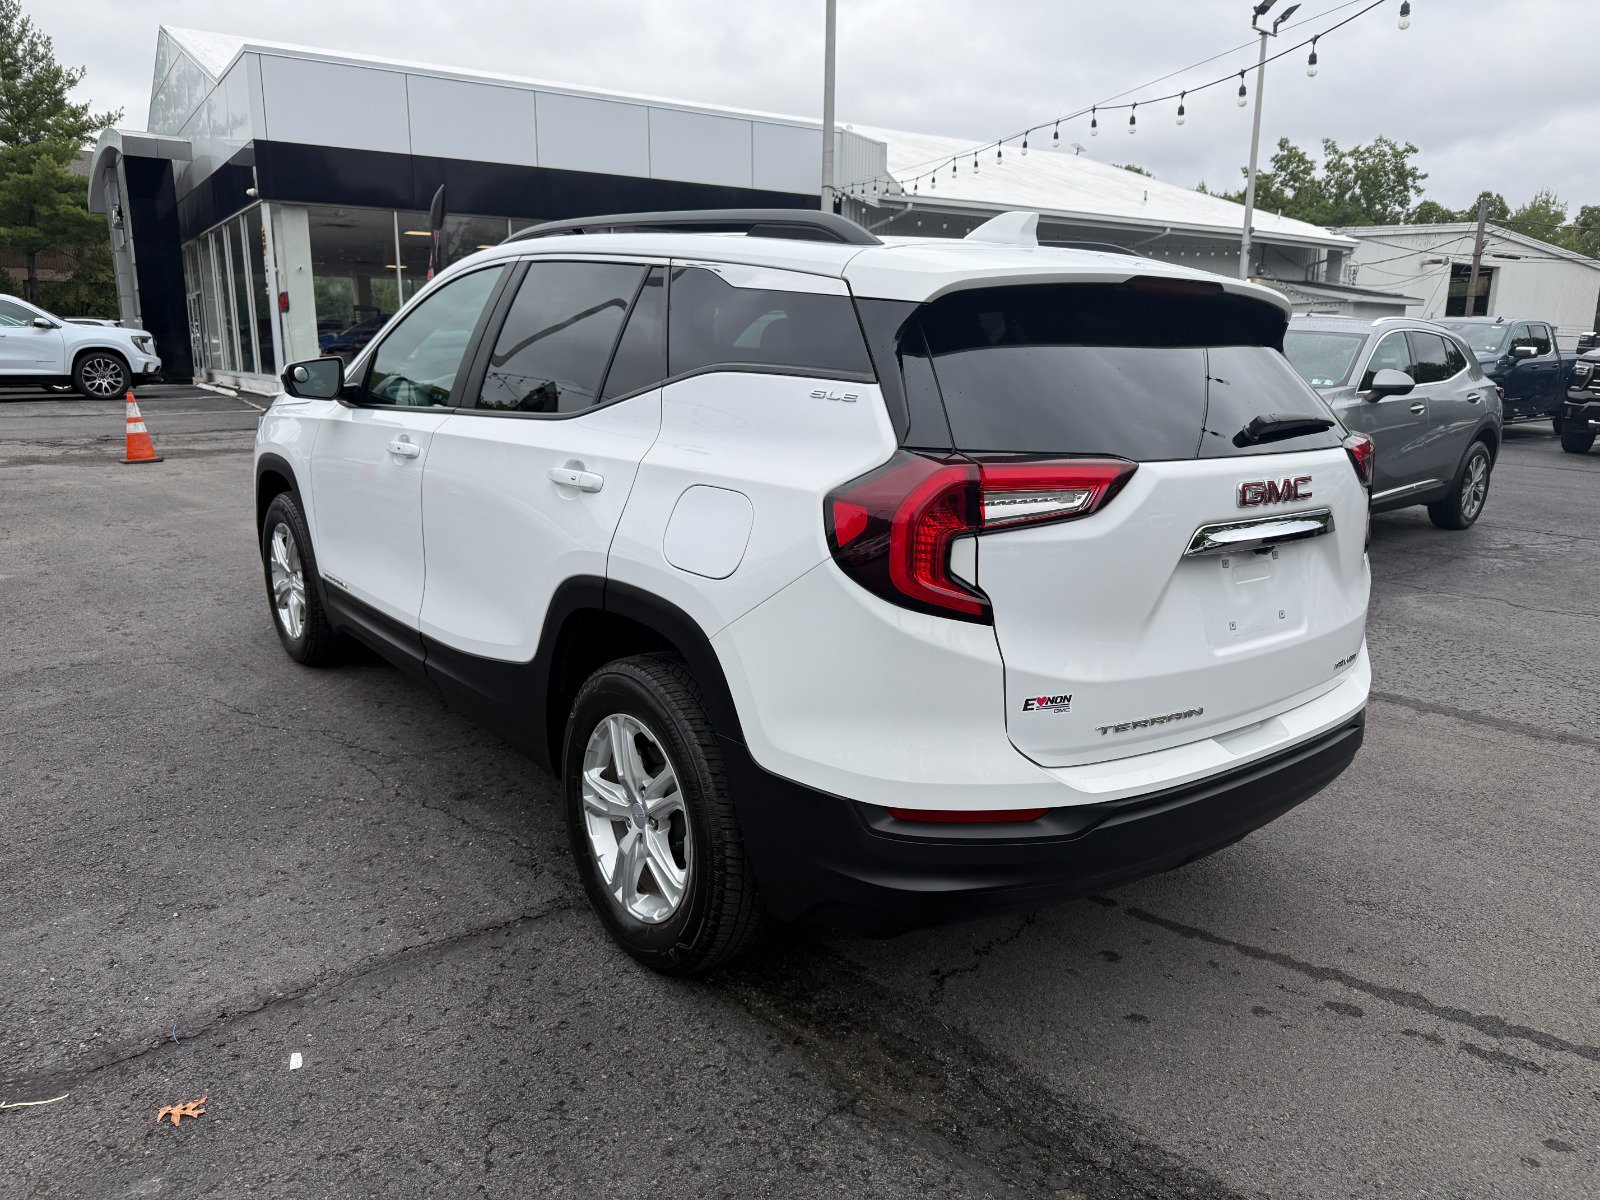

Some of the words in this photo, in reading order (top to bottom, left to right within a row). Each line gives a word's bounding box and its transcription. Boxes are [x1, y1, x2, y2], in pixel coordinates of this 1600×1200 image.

[1236, 476, 1312, 508] GMC
[1022, 695, 1073, 712] ENON
[1095, 707, 1204, 735] TERRAIN
